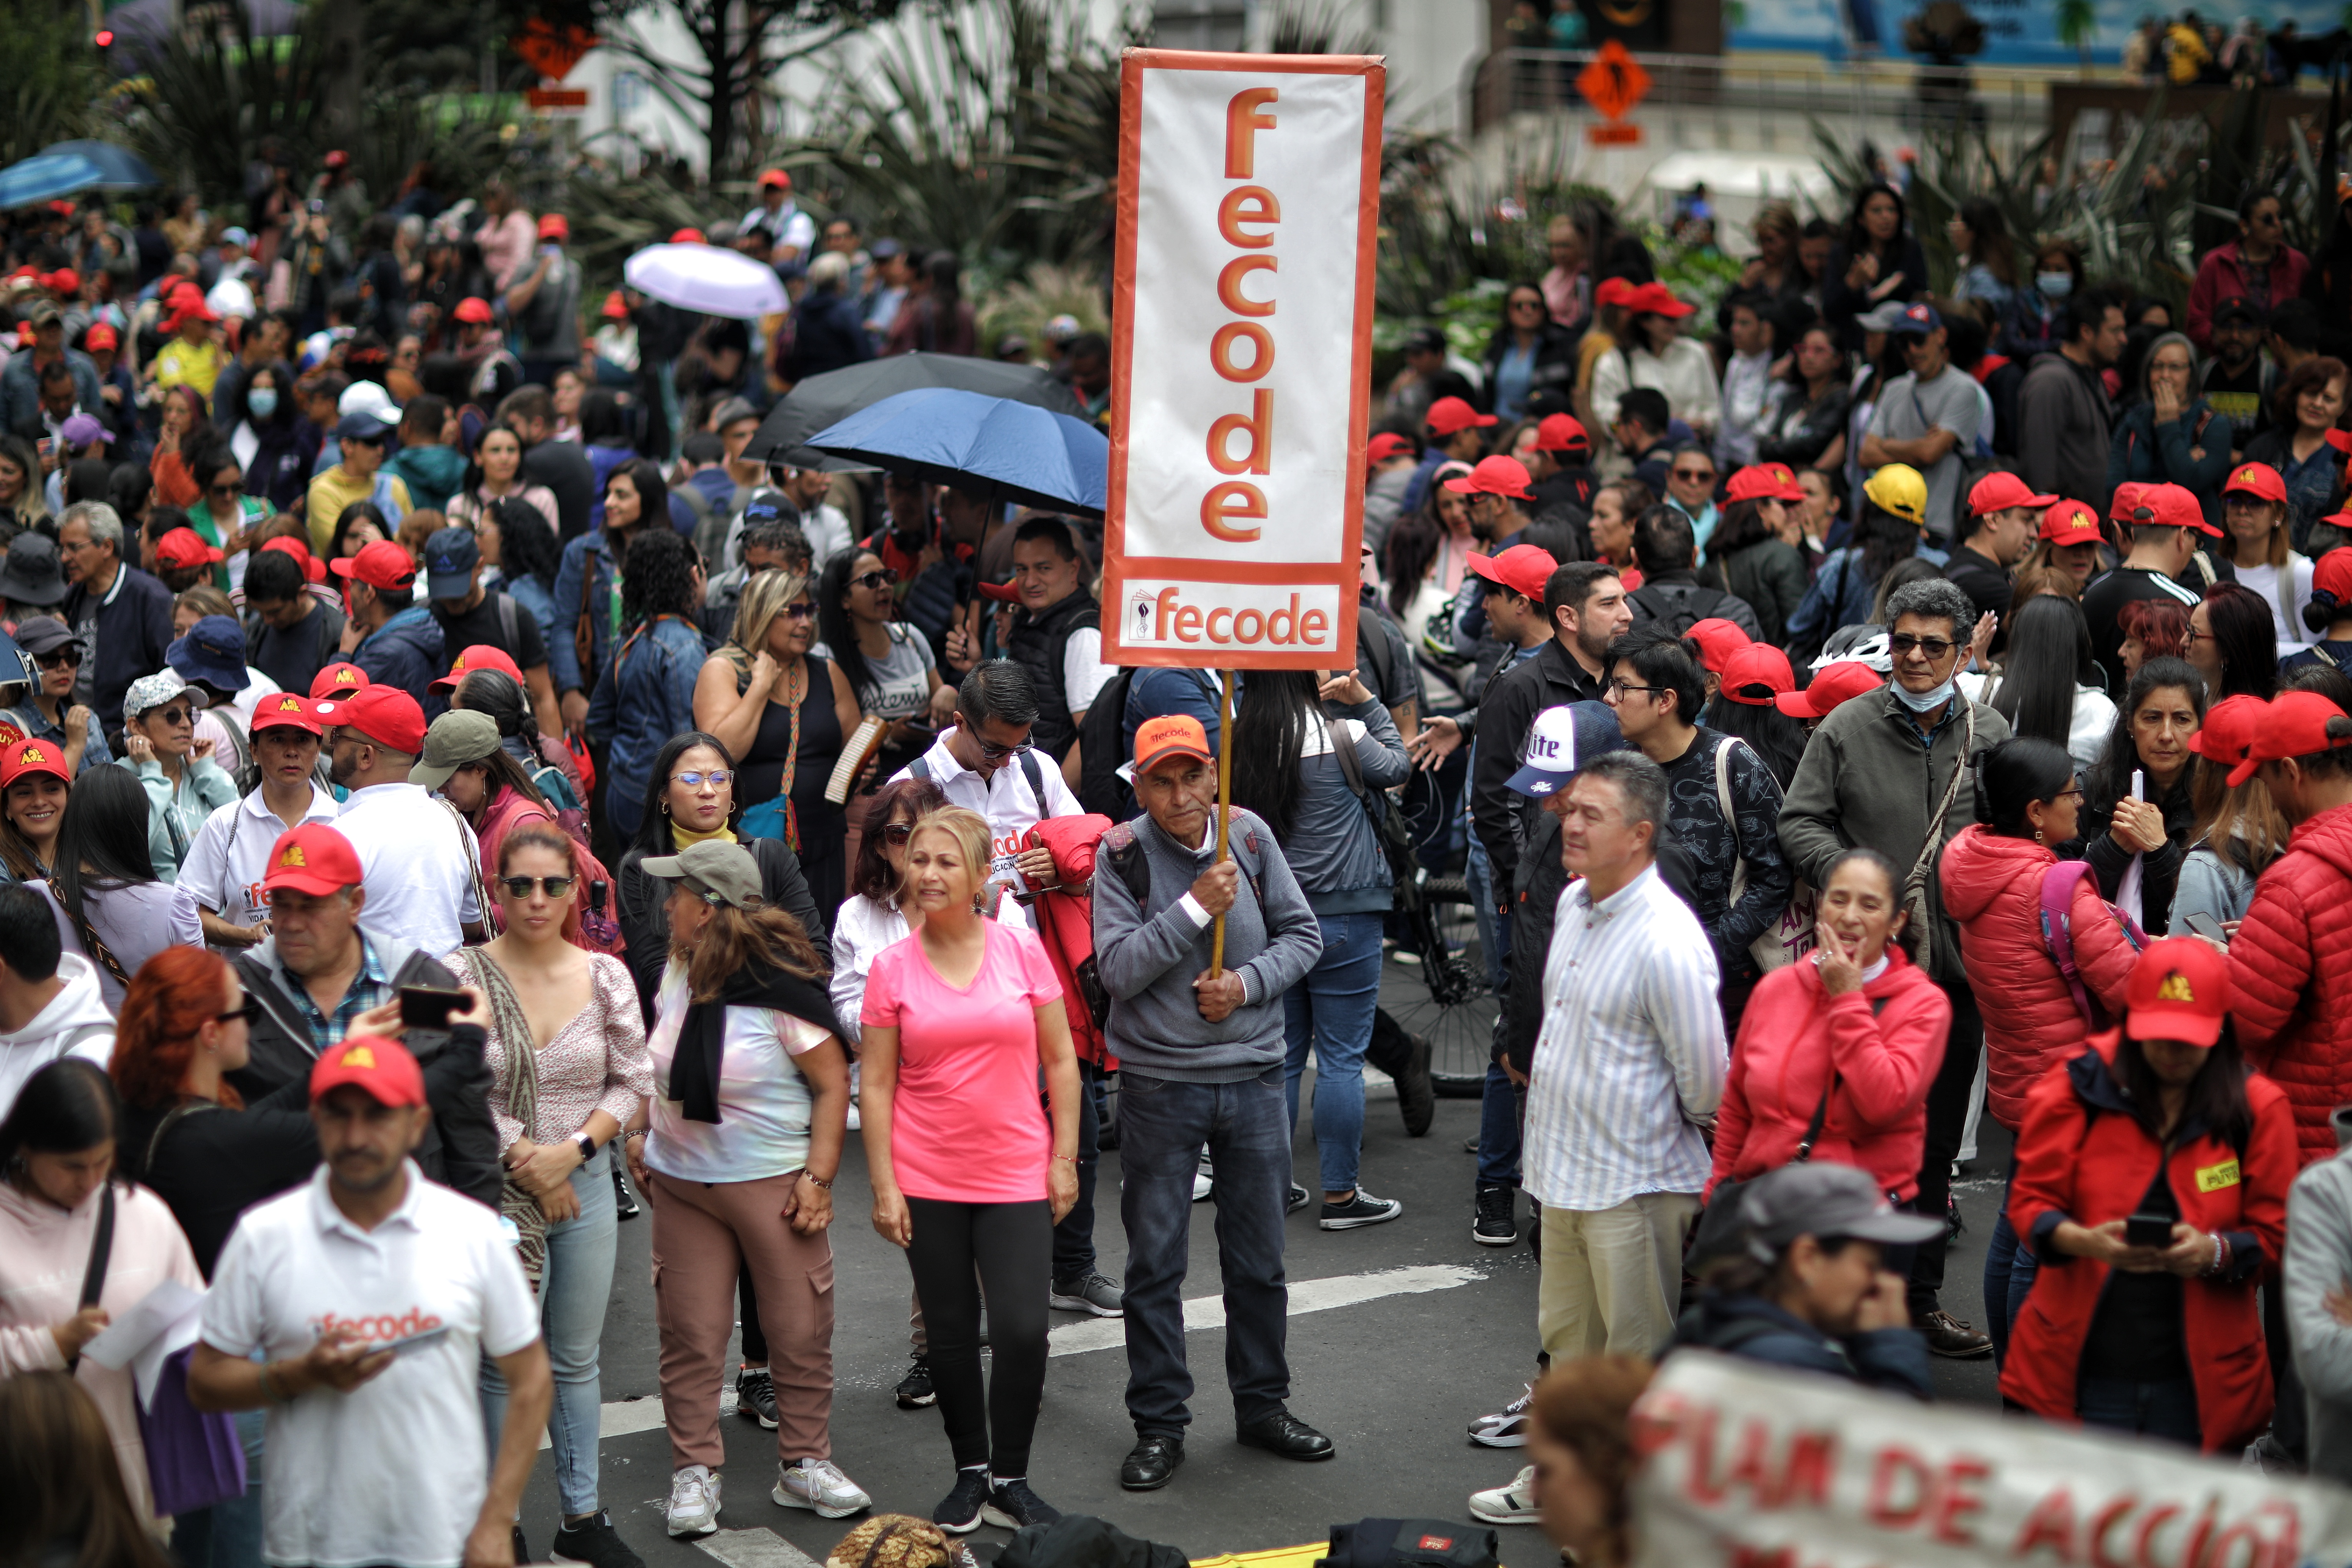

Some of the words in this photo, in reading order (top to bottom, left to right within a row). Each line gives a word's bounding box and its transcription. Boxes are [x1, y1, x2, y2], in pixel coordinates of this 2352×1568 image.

[1200, 87, 1281, 543] fecode
[1155, 586, 1329, 645] fecode
[1868, 1443, 1992, 1547] DE
